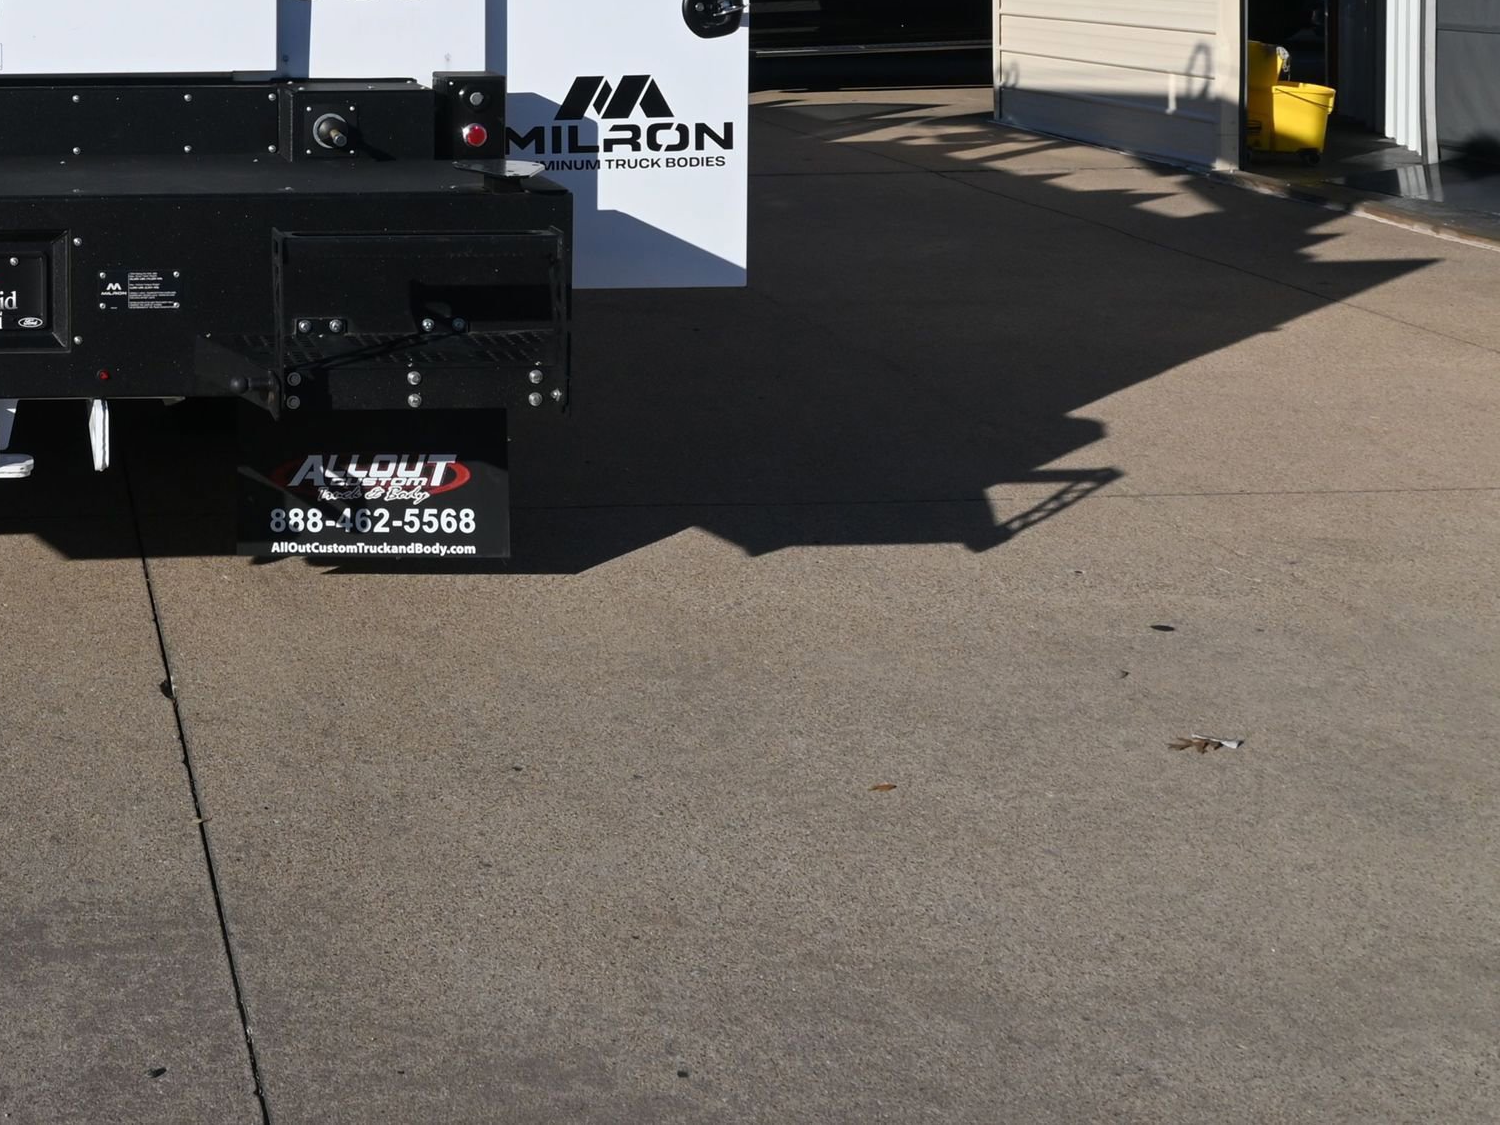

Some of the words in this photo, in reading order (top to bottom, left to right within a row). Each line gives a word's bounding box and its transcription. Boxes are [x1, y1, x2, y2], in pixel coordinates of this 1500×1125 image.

[505, 122, 733, 155] MILRON
[536, 159, 601, 171] MINUM
[605, 158, 661, 169] TRUCK
[665, 156, 726, 168] BODIES
[287, 454, 458, 487] ALLOUT
[364, 487, 385, 500] &
[384, 485, 430, 505] Body
[270, 508, 476, 534] 888-462-5568
[271, 542, 476, 556] AllOutCustomTruckandBody.com
